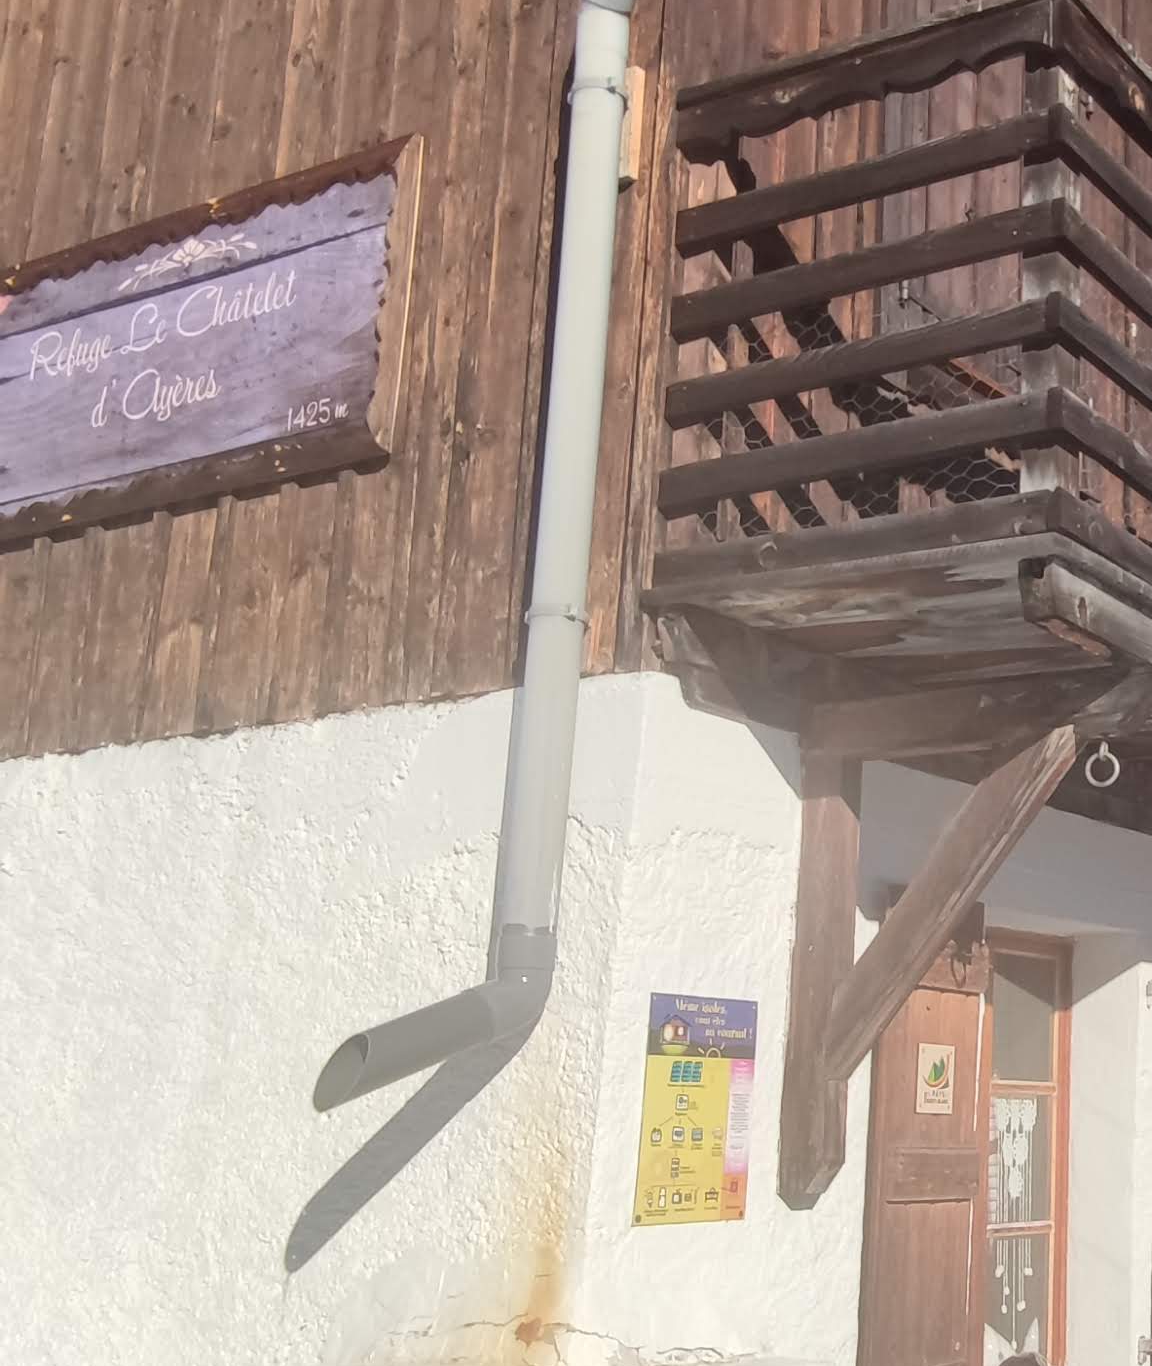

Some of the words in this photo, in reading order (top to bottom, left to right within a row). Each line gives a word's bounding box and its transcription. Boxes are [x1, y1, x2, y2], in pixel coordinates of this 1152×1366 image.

[30, 327, 114, 381] Refuge
[120, 302, 168, 356] Le
[176, 269, 297, 337] Châtelet
[286, 397, 331, 432] 1425
